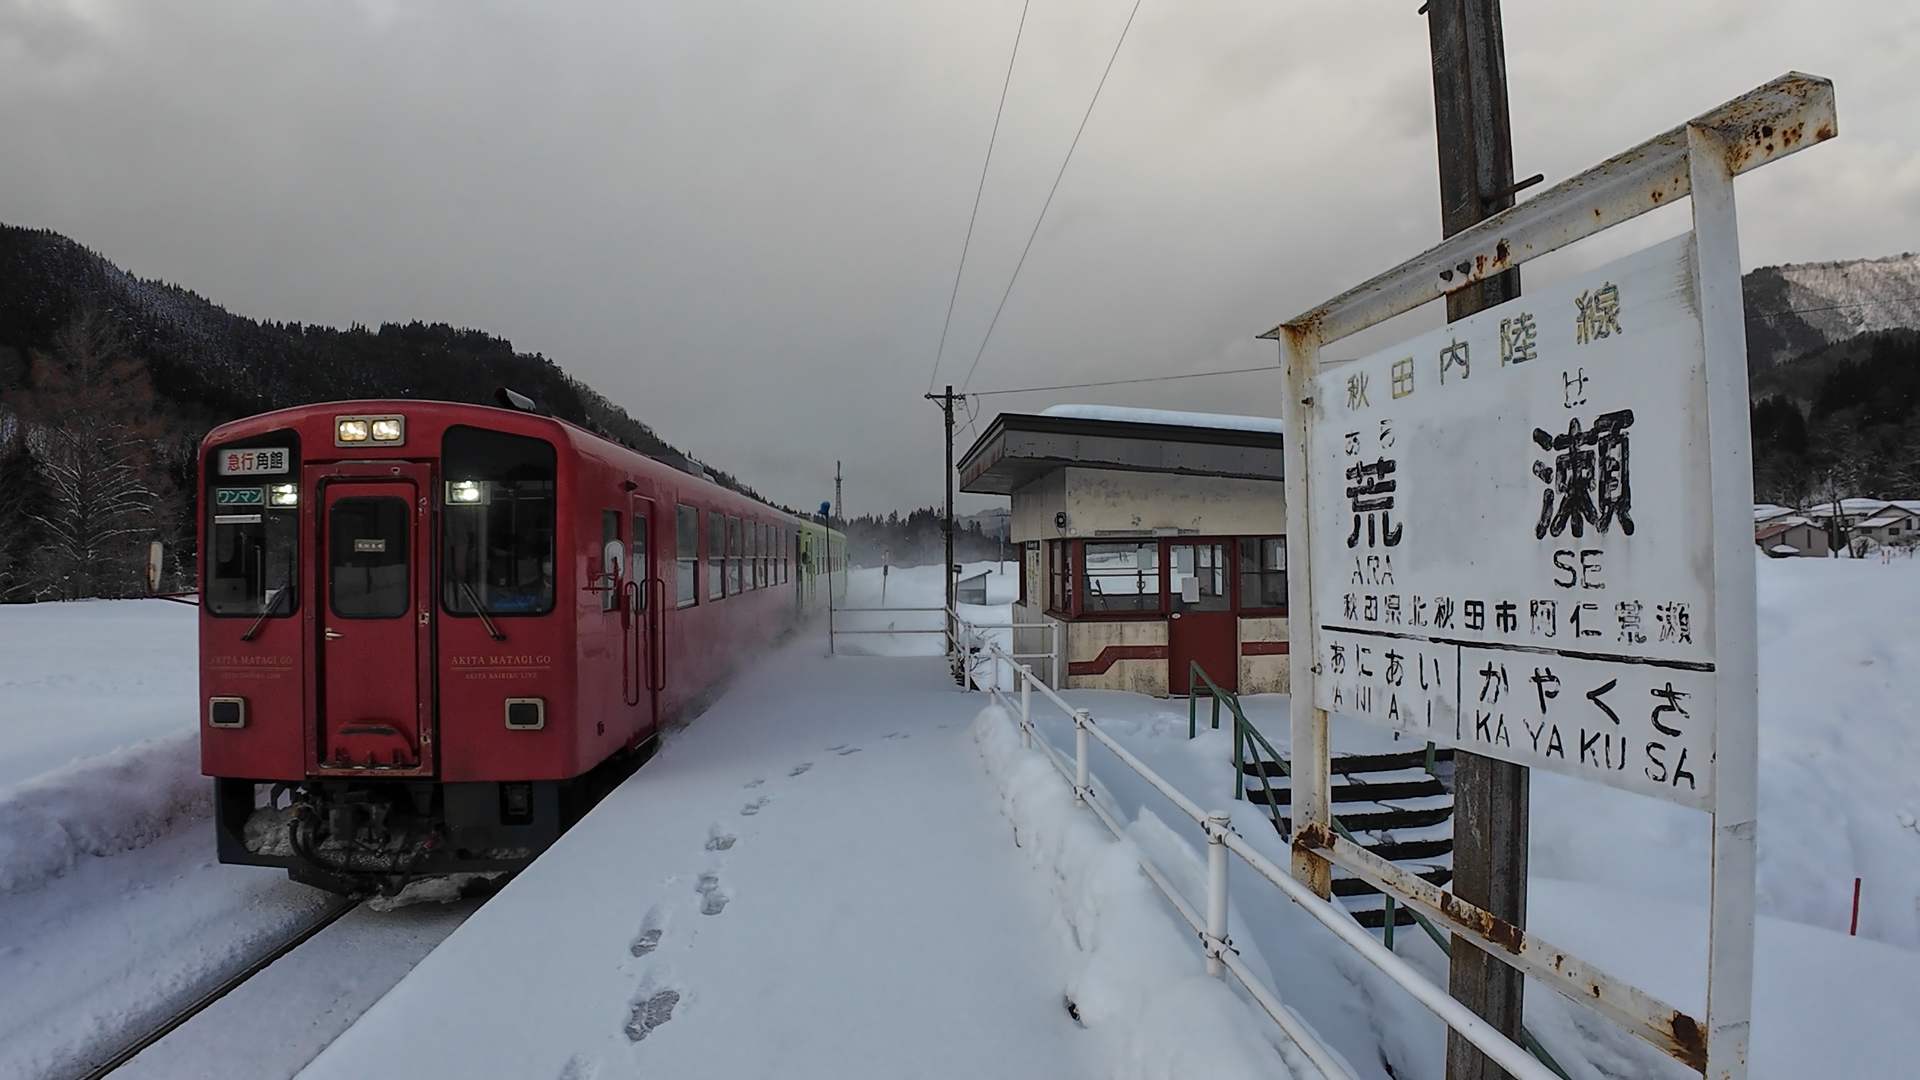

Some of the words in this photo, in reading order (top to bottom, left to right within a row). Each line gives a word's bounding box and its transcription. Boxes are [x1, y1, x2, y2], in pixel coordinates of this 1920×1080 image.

[1346, 281, 1623, 412] 秋田内陸線
[218, 489, 262, 503] ワンマン
[1351, 554, 1395, 586] ARA
[1552, 549, 1606, 589] SE
[240, 655, 277, 665] MATAGI
[279, 655, 293, 665] GO
[451, 655, 485, 665] AKITA
[489, 655, 533, 665] MATAGI
[536, 655, 551, 664] GO
[1329, 641, 1442, 691] あにあい
[1478, 660, 1692, 738] かやくさ
